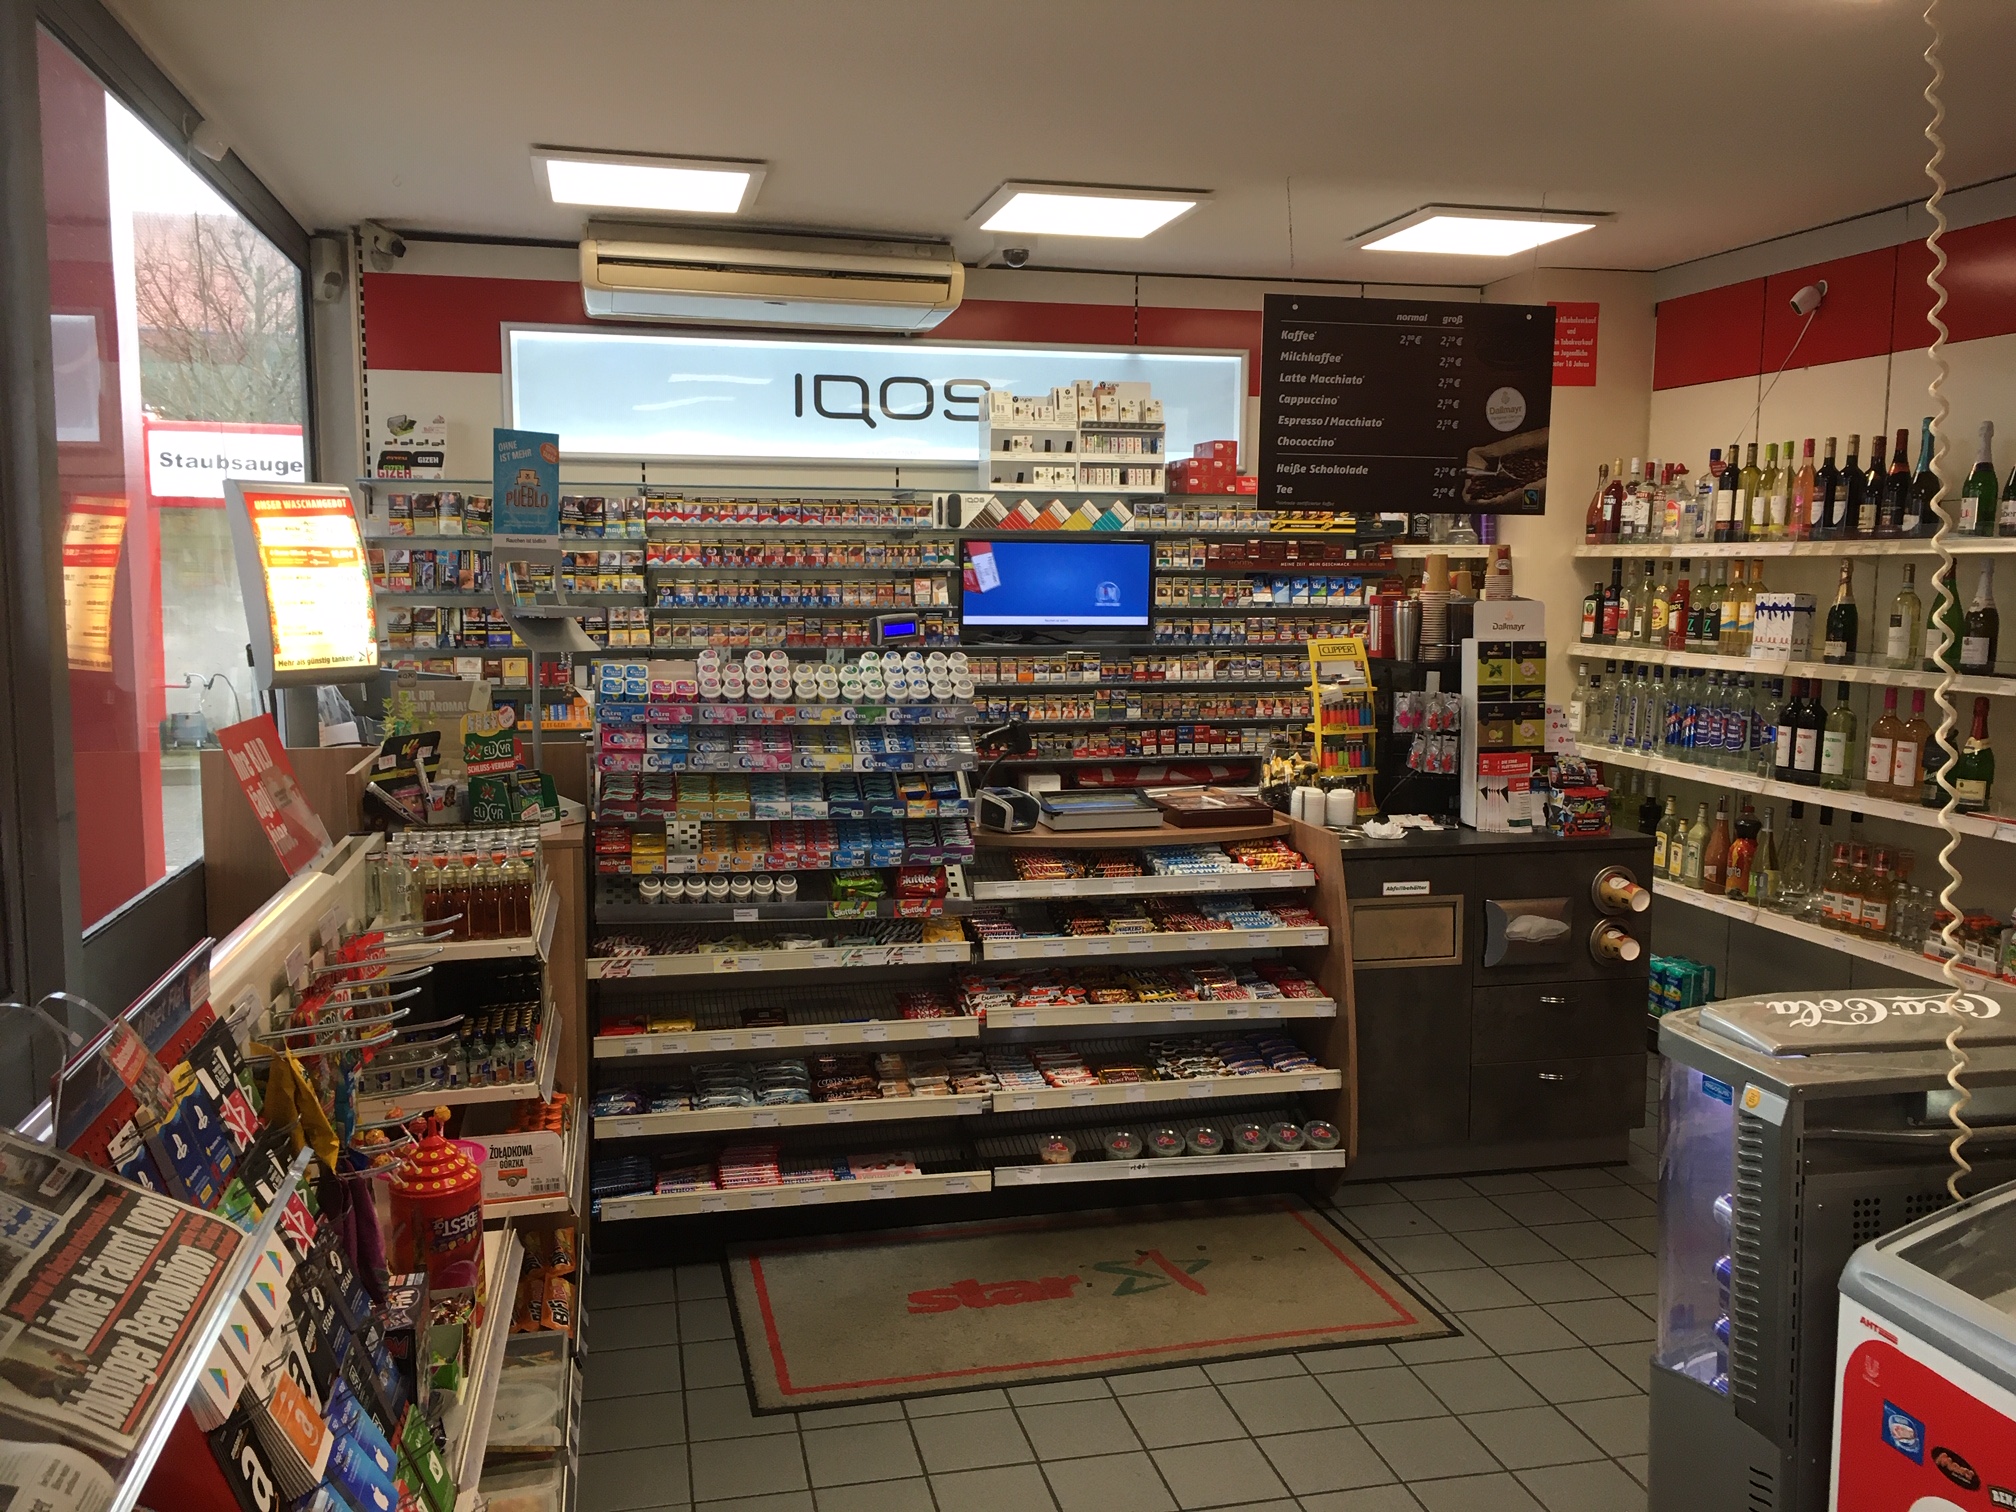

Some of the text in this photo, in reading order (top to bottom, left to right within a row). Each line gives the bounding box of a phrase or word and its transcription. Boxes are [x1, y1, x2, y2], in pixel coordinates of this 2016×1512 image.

[1396, 313, 1463, 324] normal groß
[1279, 373, 1307, 383] Latte
[795, 373, 991, 429] IQOS
[498, 440, 517, 452] OHNE
[499, 449, 532, 462] IST MEHR
[159, 451, 304, 478] Staubsauge
[1276, 463, 1307, 475] Heiße
[1309, 464, 1369, 475] Schokolade
[1276, 485, 1293, 494] Tee
[505, 485, 548, 508] PUEBLO
[254, 498, 347, 510] UNSER WASCHANGEBOT
[1492, 622, 1526, 632] Dallmayr
[1322, 645, 1355, 654] CLIPPER
[278, 659, 294, 667] Mehr
[307, 657, 331, 666] günstig
[418, 690, 436, 700] DIR
[430, 702, 467, 713] AROMA!
[467, 760, 515, 774] SCHLUSS-VERKAUF
[840, 869, 875, 878] Skittle
[901, 875, 937, 884] Skittles
[1386, 884, 1427, 893] Abfallbehälter
[834, 907, 861, 917] Skittles
[901, 906, 927, 916] Skittles
[1766, 993, 2001, 1027] Coca-Cola
[489, 1143, 534, 1160] ŻOŁĄDKOWA
[27, 1282, 117, 1353] Linke
[73, 1220, 159, 1300] träumt
[126, 1193, 180, 1236] von
[340, 1269, 354, 1296] STEAM
[114, 1243, 218, 1350] Revolution
[907, 1275, 1082, 1314] star
[321, 1304, 336, 1335] STEAM
[1860, 1316, 1879, 1332] AHT
[64, 1333, 167, 1431] blutiger
